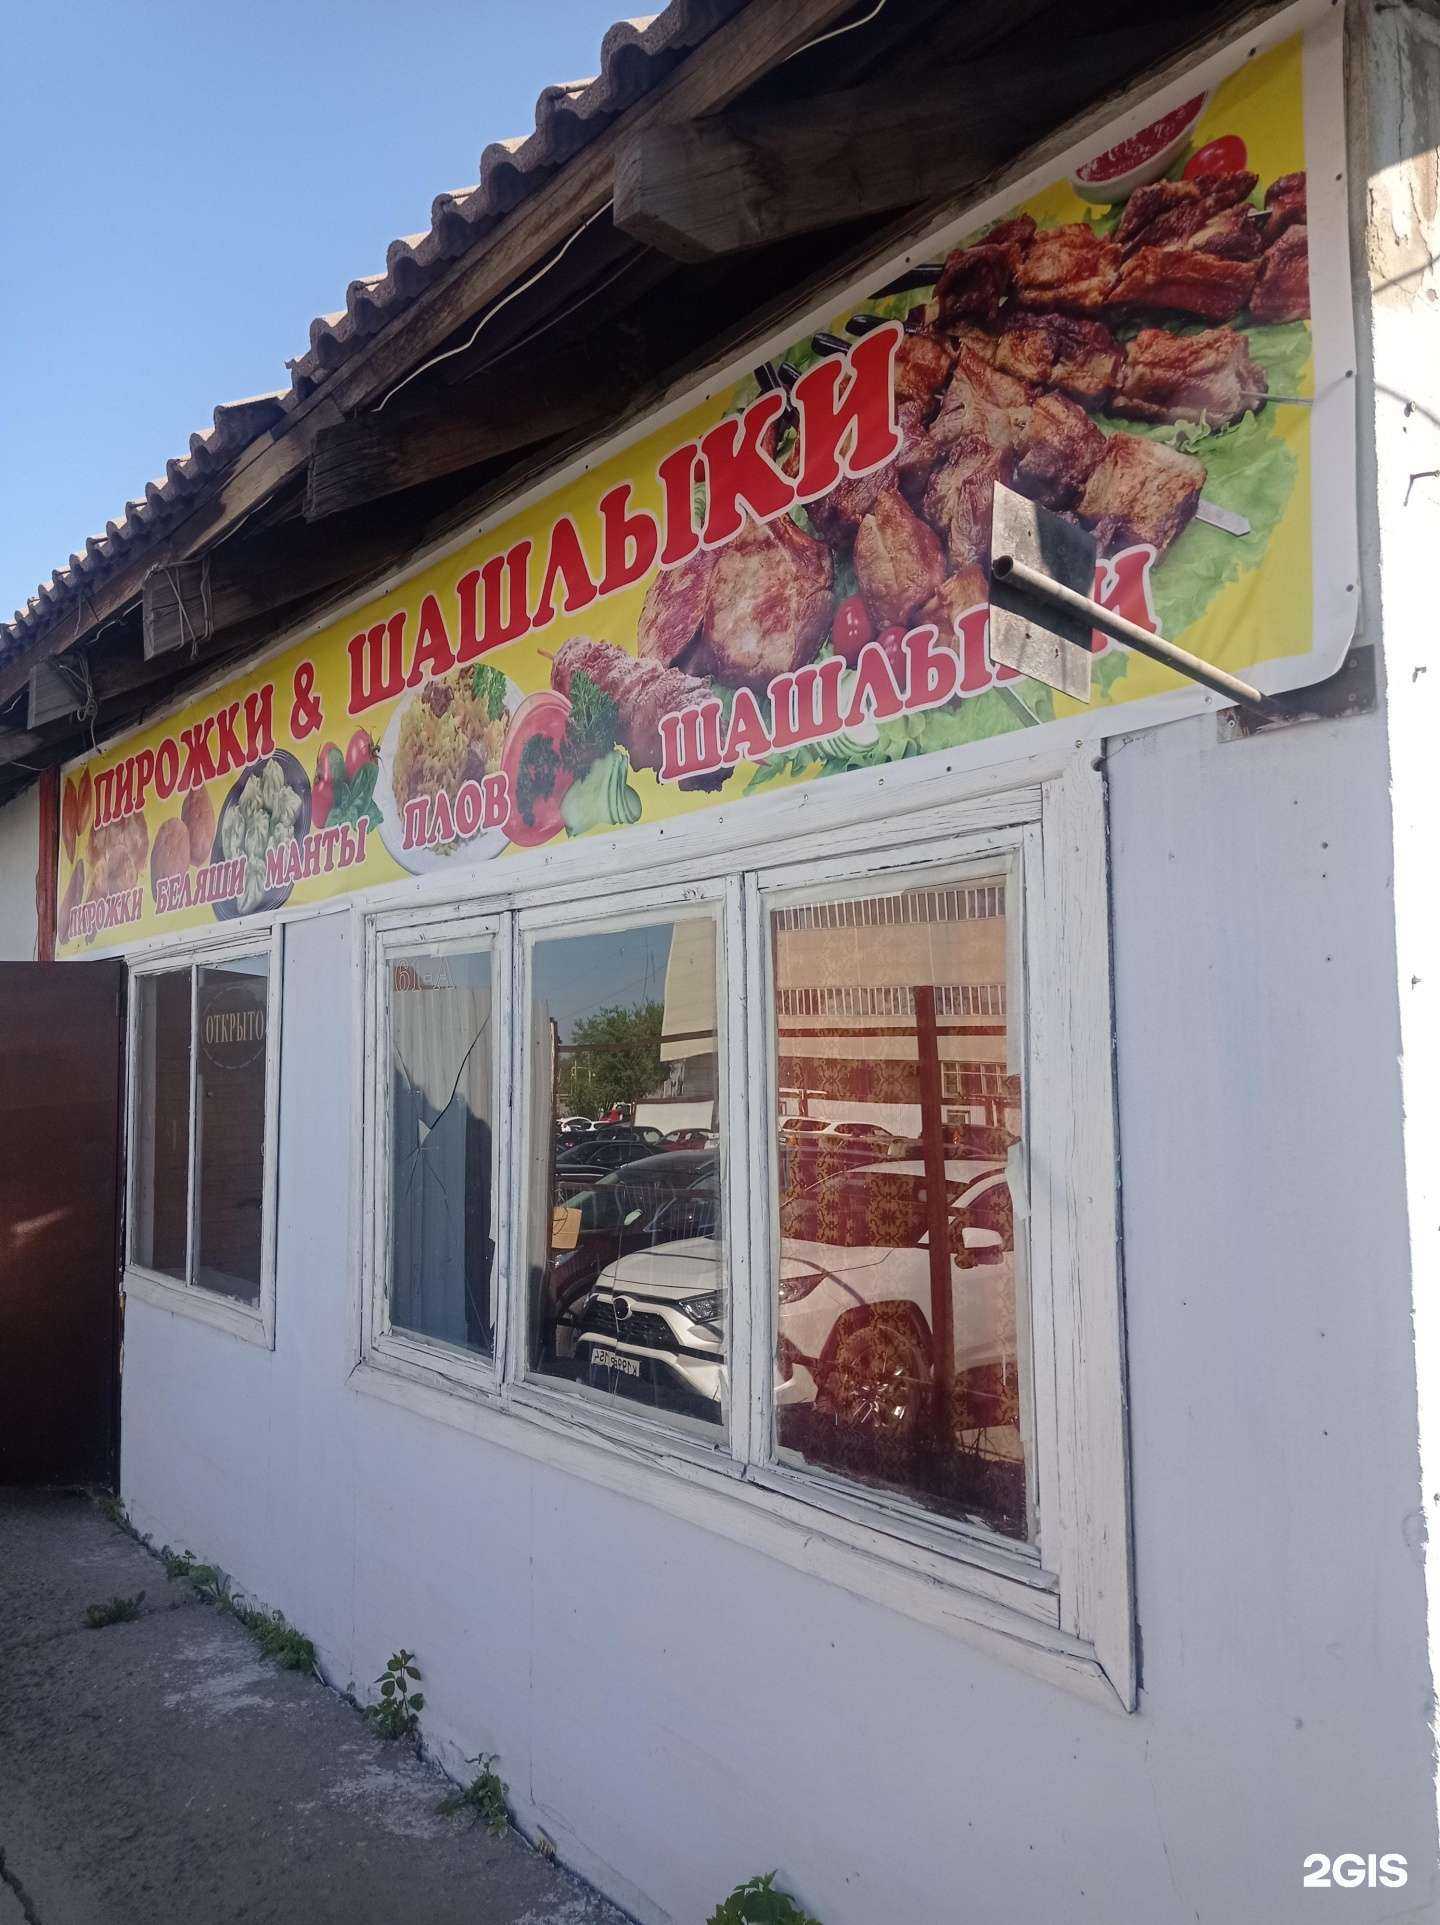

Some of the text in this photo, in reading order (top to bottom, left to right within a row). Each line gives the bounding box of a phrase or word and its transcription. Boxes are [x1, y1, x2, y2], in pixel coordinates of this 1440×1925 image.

[69, 545, 1161, 936] ПИРОЖКИ БЕЛЯШИ МАНТЫ ПЛОВ ШАШЛЫИ
[94, 322, 904, 830] ПИРОЖКИ & ШАШЛЫКИ
[206, 1010, 264, 1043] ОТКРЫТО
